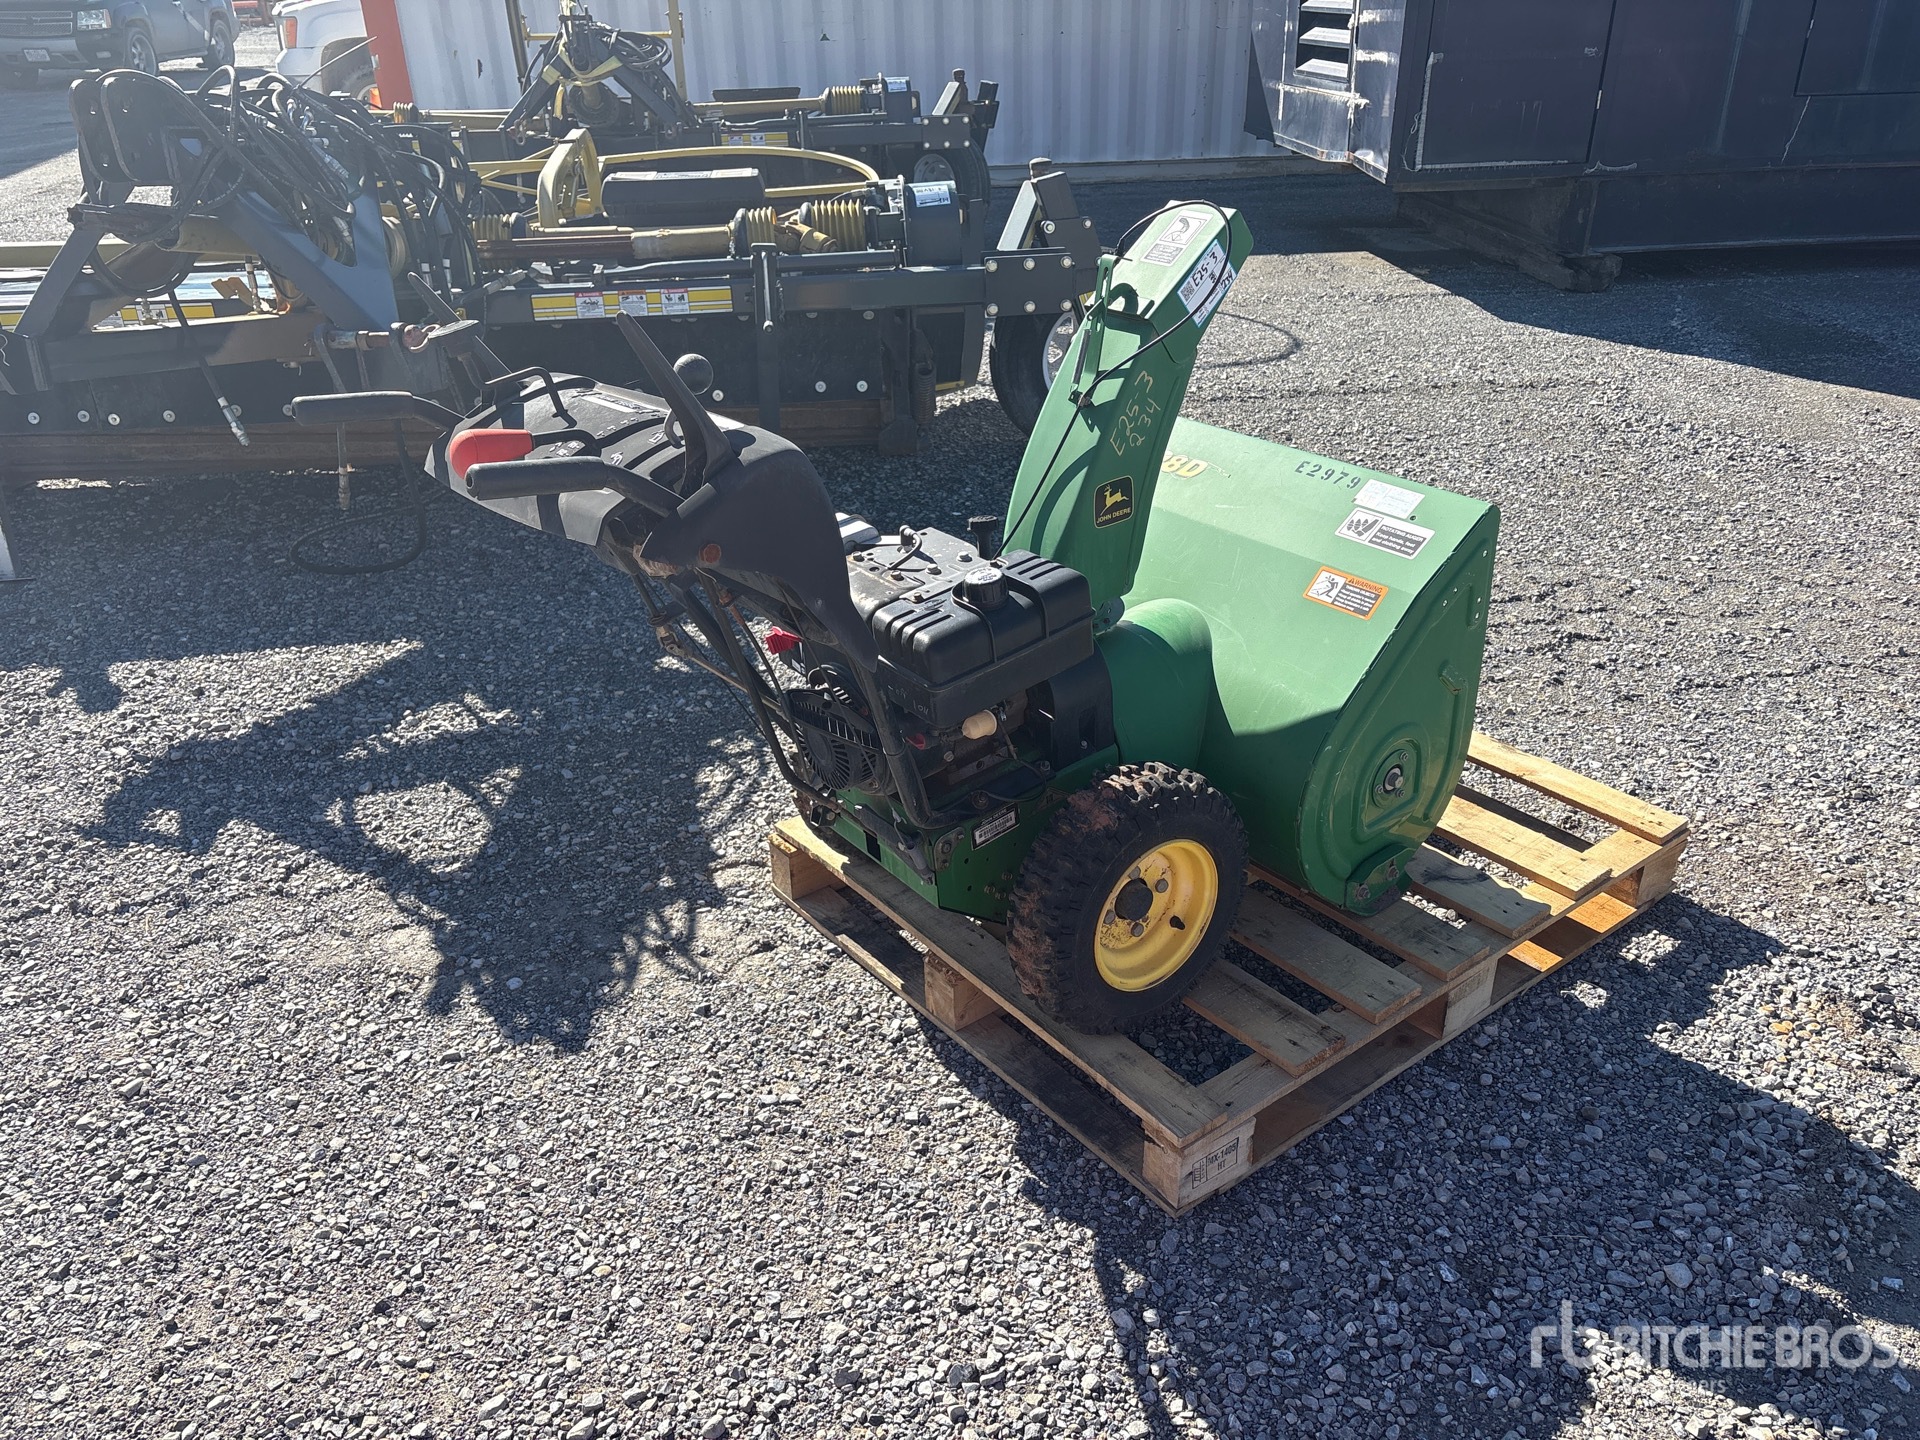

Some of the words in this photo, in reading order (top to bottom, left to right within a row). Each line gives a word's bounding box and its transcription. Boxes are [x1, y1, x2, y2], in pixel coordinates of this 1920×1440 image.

[1191, 251, 1218, 287] E25-3
[1110, 370, 1154, 457] E25-3
[1129, 398, 1161, 447] 234
[1294, 460, 1361, 489] E2979
[1096, 513, 1111, 524] JOHN
[1112, 507, 1131, 518] DEERE
[1406, 533, 1424, 542] AUGER
[1354, 579, 1383, 593] WARNING
[1217, 1158, 1227, 1171] HT
